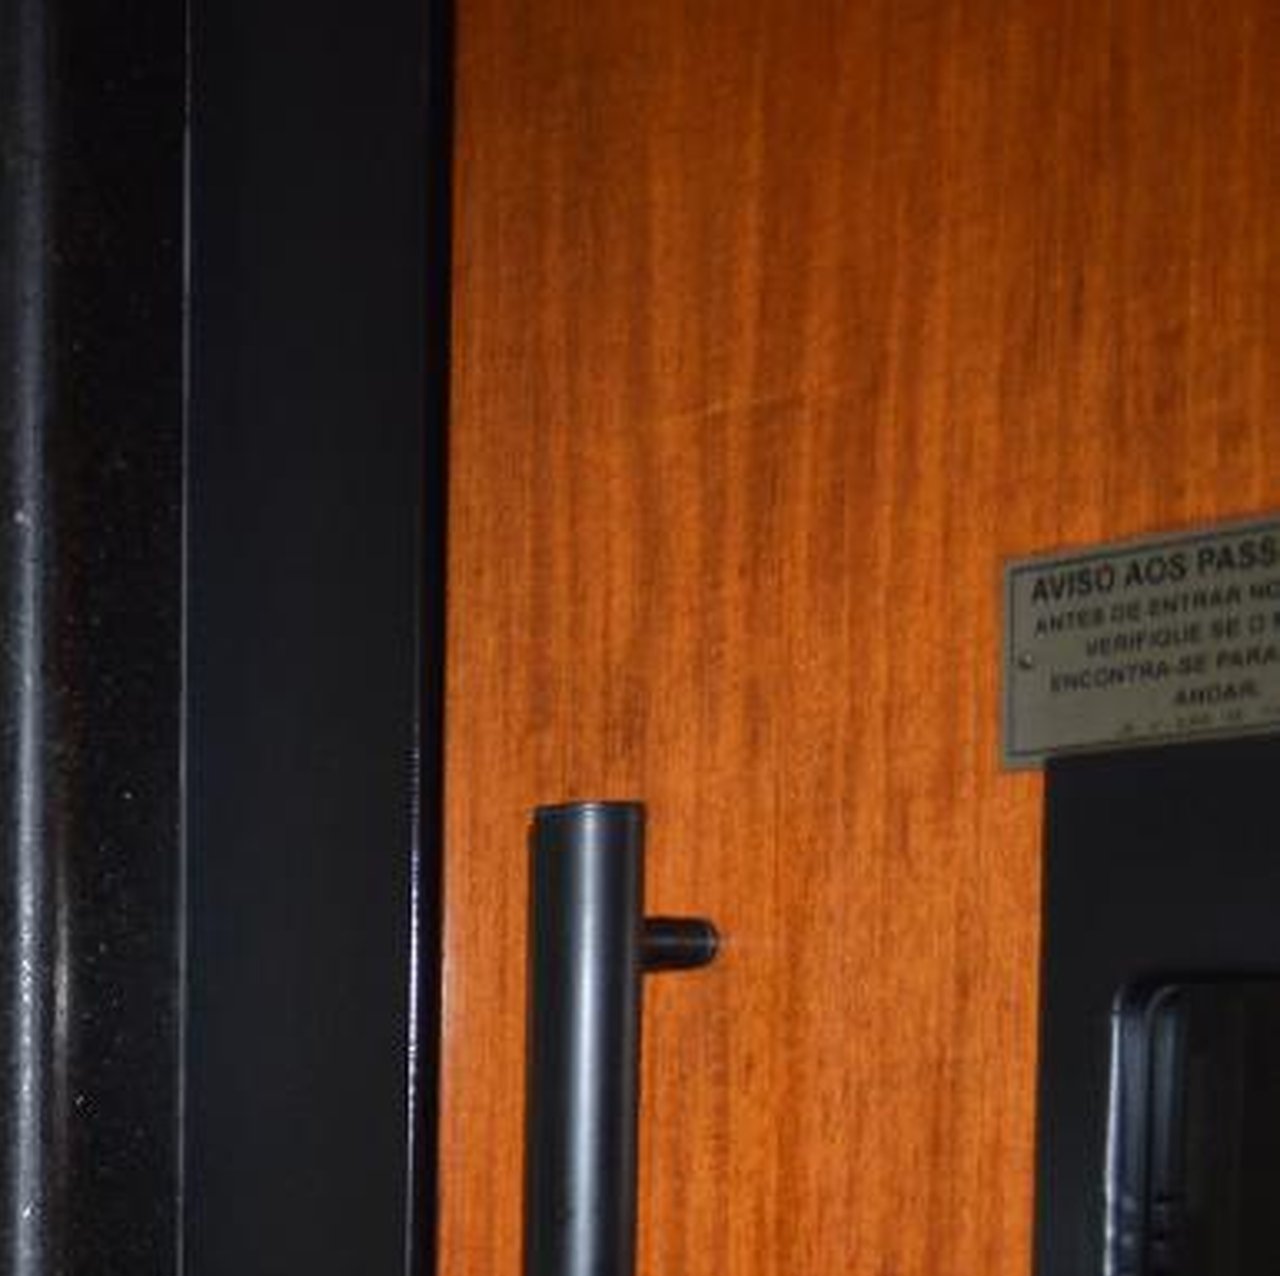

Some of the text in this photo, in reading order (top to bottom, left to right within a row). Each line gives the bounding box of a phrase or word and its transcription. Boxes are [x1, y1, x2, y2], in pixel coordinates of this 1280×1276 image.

[1032, 536, 1278, 603] AVISO AOS PASS
[1034, 607, 1104, 638] ANTES
[1110, 602, 1139, 623] DE
[1147, 586, 1240, 617] ENTRAR
[1085, 622, 1200, 658] VERIFIQUE
[1210, 618, 1240, 639] SE
